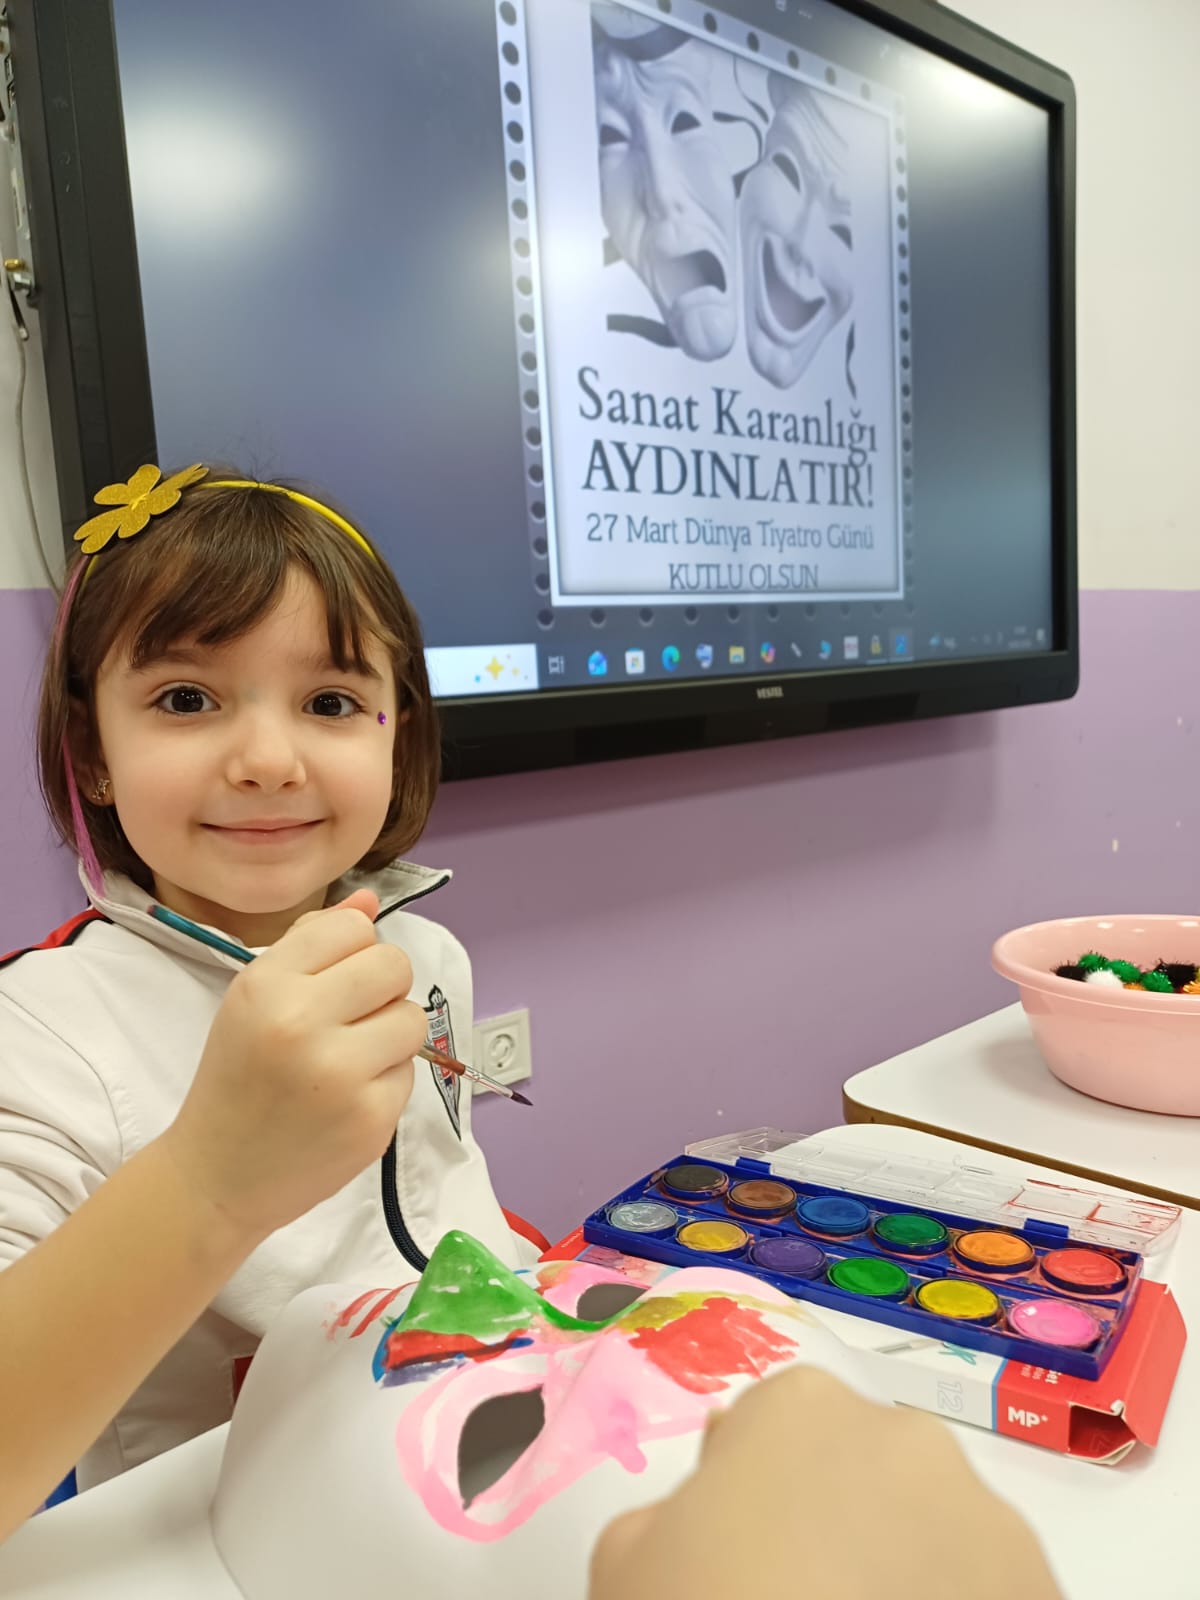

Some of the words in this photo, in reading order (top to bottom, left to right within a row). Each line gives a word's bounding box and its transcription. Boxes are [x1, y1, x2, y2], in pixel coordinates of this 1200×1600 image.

[577, 366, 699, 432] Sanat
[711, 386, 877, 467] Karanlığı
[581, 438, 874, 508] AYDINLATIR!
[586, 513, 618, 542] 27
[626, 515, 678, 544] Mart
[685, 517, 751, 552] Dünya
[827, 523, 874, 550] Günü
[669, 563, 743, 590] KUTLU
[749, 563, 819, 590] OLSUN
